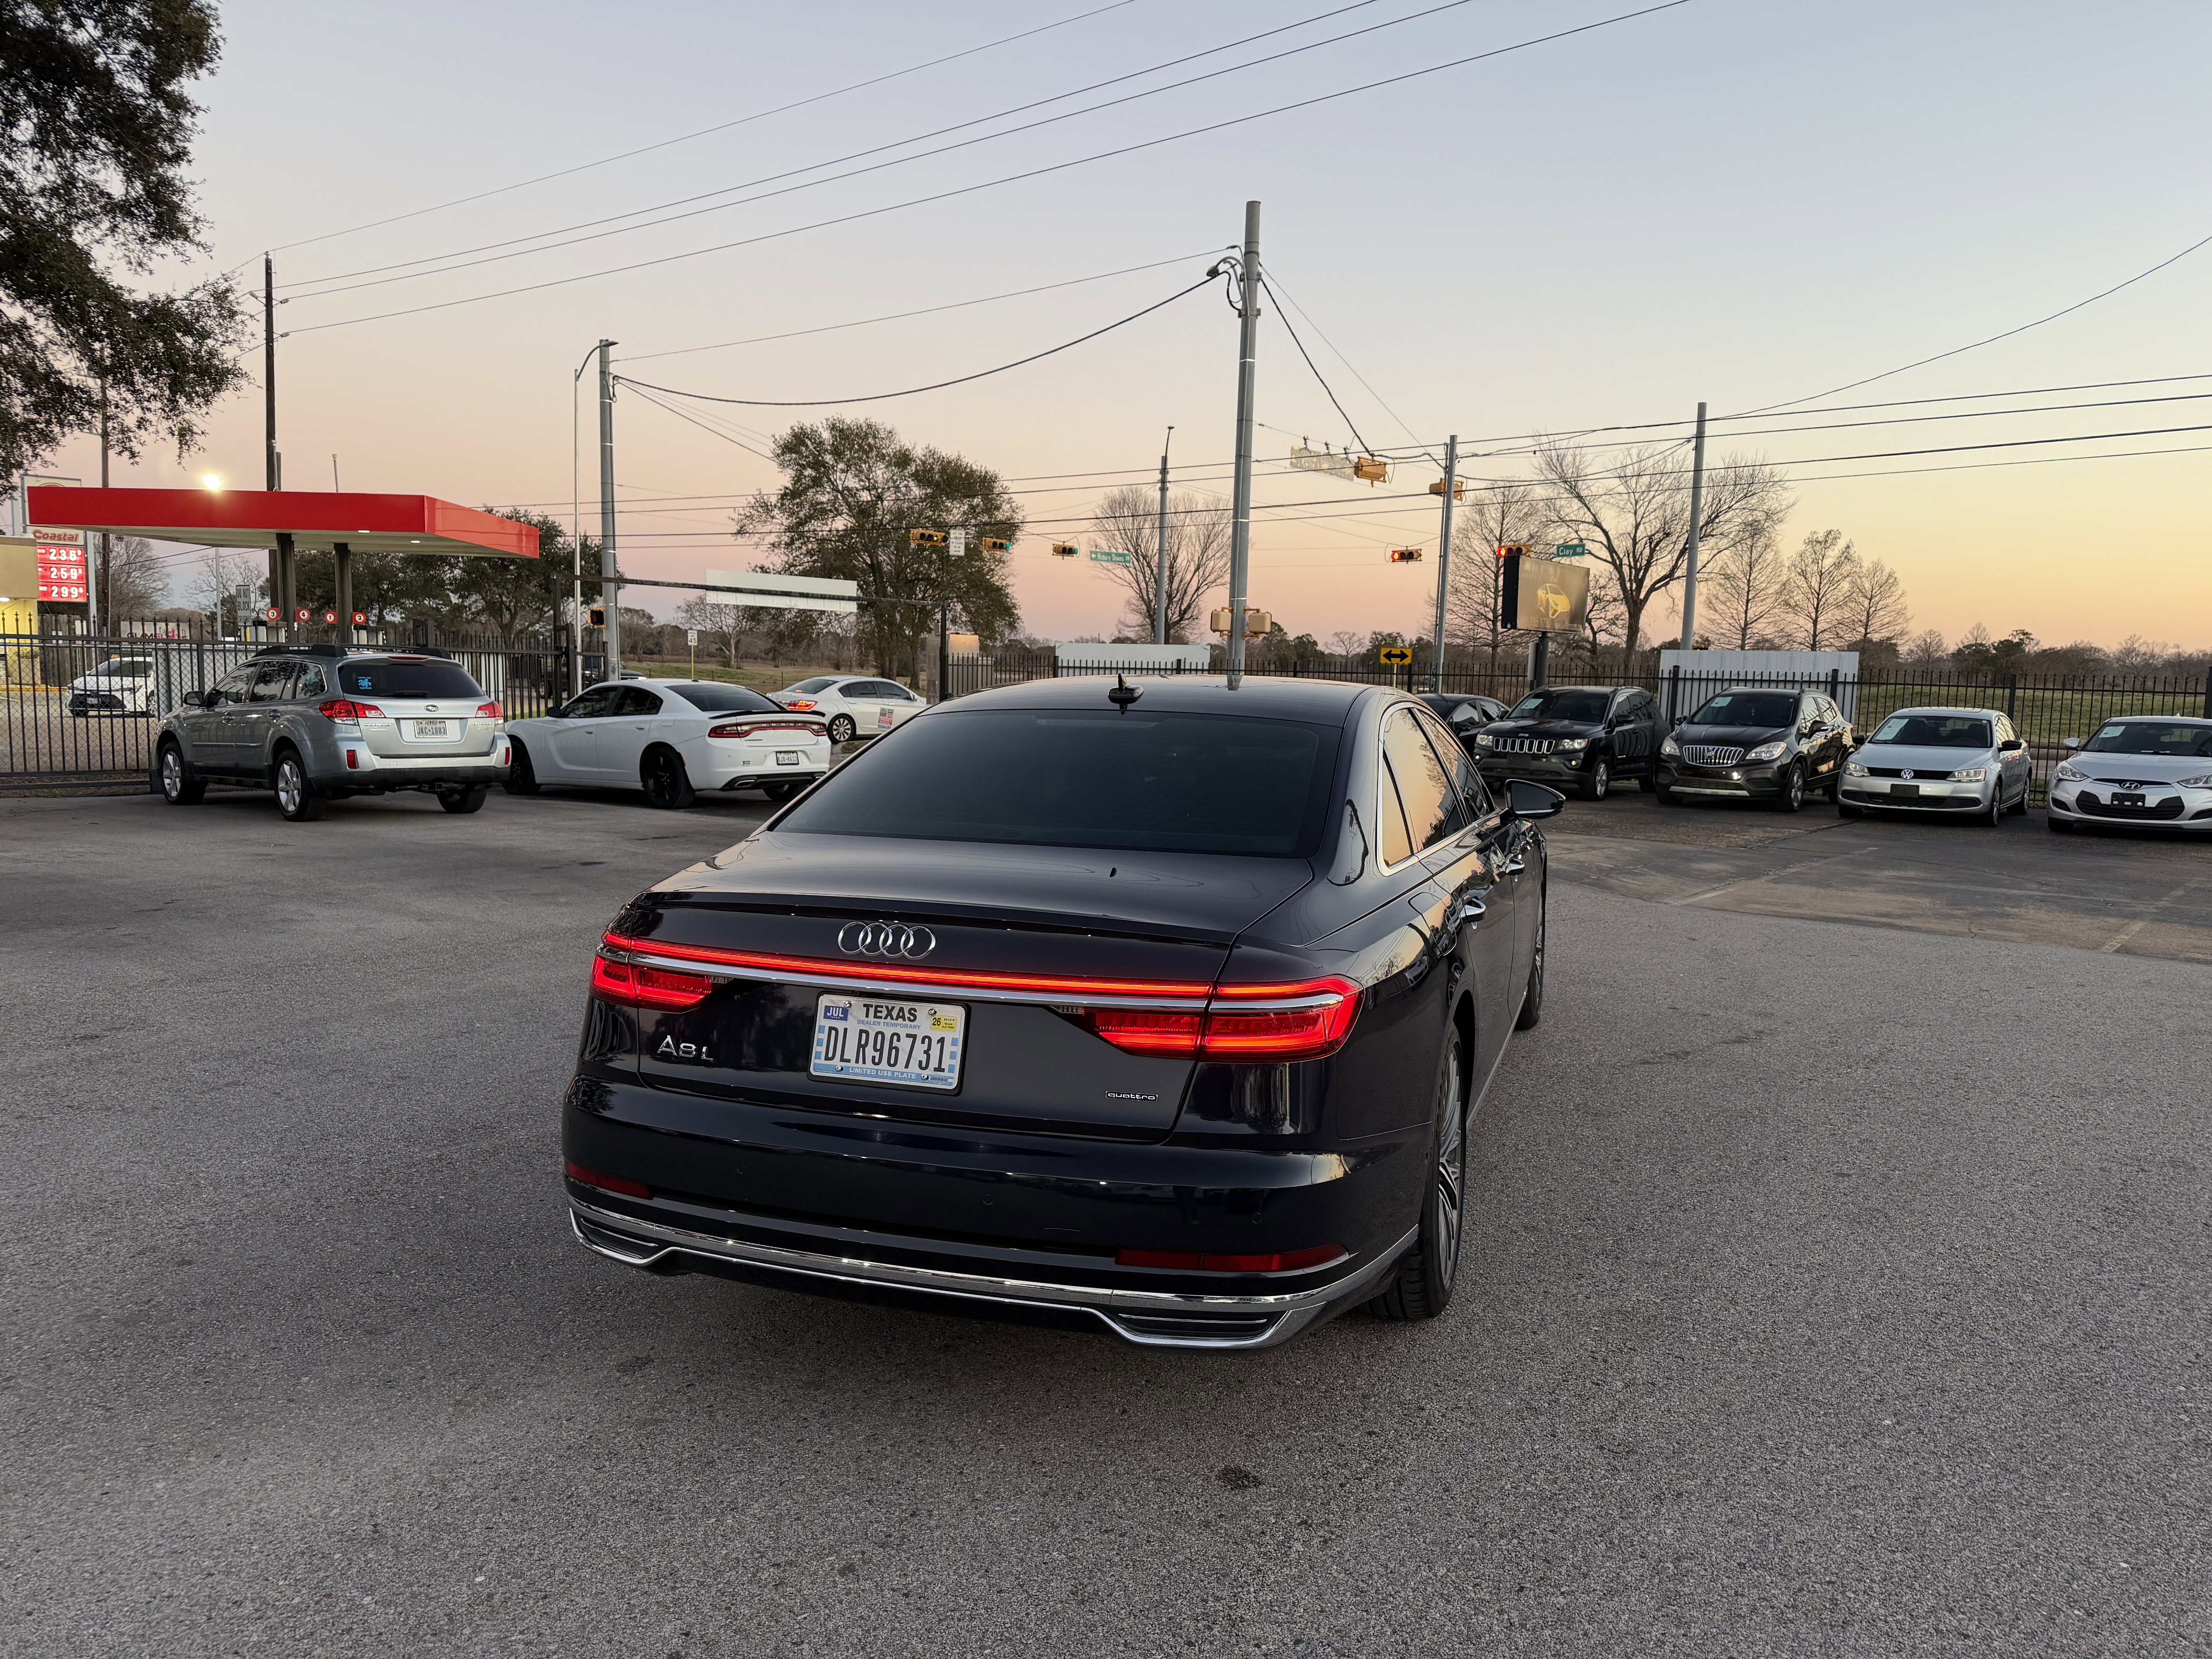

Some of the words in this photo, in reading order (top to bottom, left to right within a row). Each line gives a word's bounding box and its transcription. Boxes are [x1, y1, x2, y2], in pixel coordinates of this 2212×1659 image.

[32, 529, 79, 542] Coastal
[1559, 547, 1573, 556] Clay
[1097, 553, 1111, 562] Hickory
[237, 588, 242, 598] DO
[238, 601, 250, 611] BLOCK
[827, 1007, 843, 1017] JUL
[863, 1003, 917, 1022] TEXAS
[883, 1022, 921, 1030] TEMPORARY
[932, 1017, 941, 1026] 26
[824, 1026, 946, 1073] DLR96731
